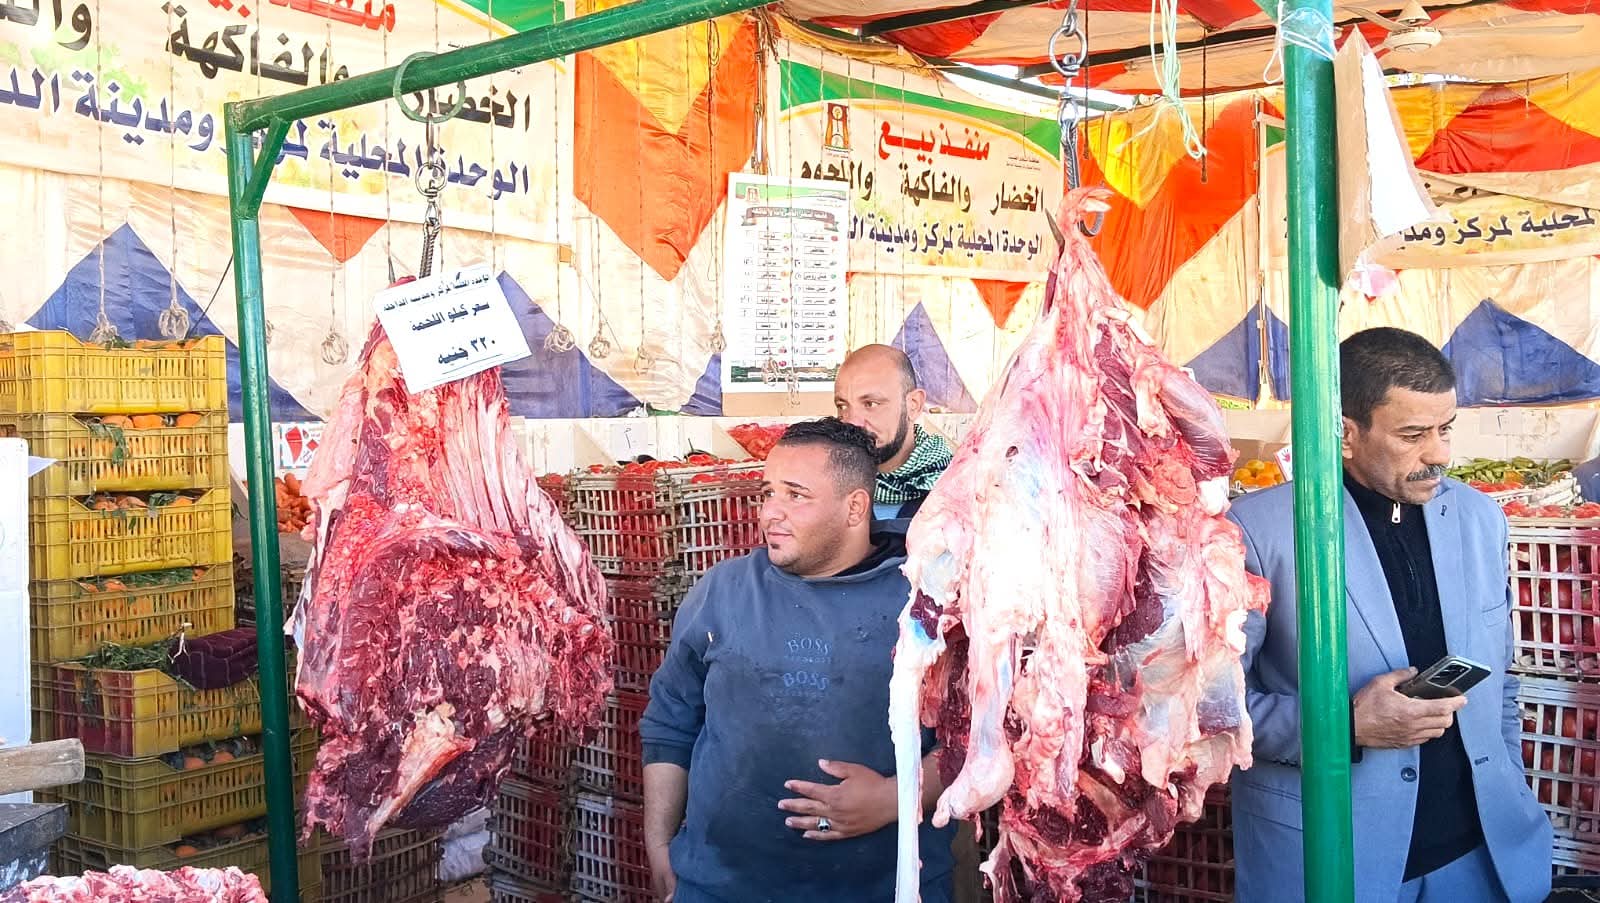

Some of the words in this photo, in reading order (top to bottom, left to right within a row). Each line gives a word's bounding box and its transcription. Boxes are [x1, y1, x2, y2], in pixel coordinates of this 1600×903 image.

[72, 70, 213, 151] ومدينة
[318, 119, 423, 179] المحلية
[879, 121, 936, 165] بيع
[939, 121, 990, 161] منفذ
[899, 160, 972, 213] والفاكهة
[990, 181, 1044, 215] الخضار
[847, 214, 864, 240] ال
[869, 213, 918, 253] ومدينة
[1453, 215, 1512, 244] لمركز
[1520, 207, 1595, 237] لمحلية
[922, 220, 953, 255] لمركز
[957, 223, 1000, 256] المحلية
[1002, 230, 1043, 261] الوحدة
[409, 311, 446, 331] اللحمة
[447, 303, 469, 323] كيلو
[471, 302, 490, 316] سعر
[438, 346, 469, 366] جنيه
[470, 336, 496, 352] ٣٢٠
[788, 638, 828, 655] BOSS
[784, 671, 829, 690] BOSS
